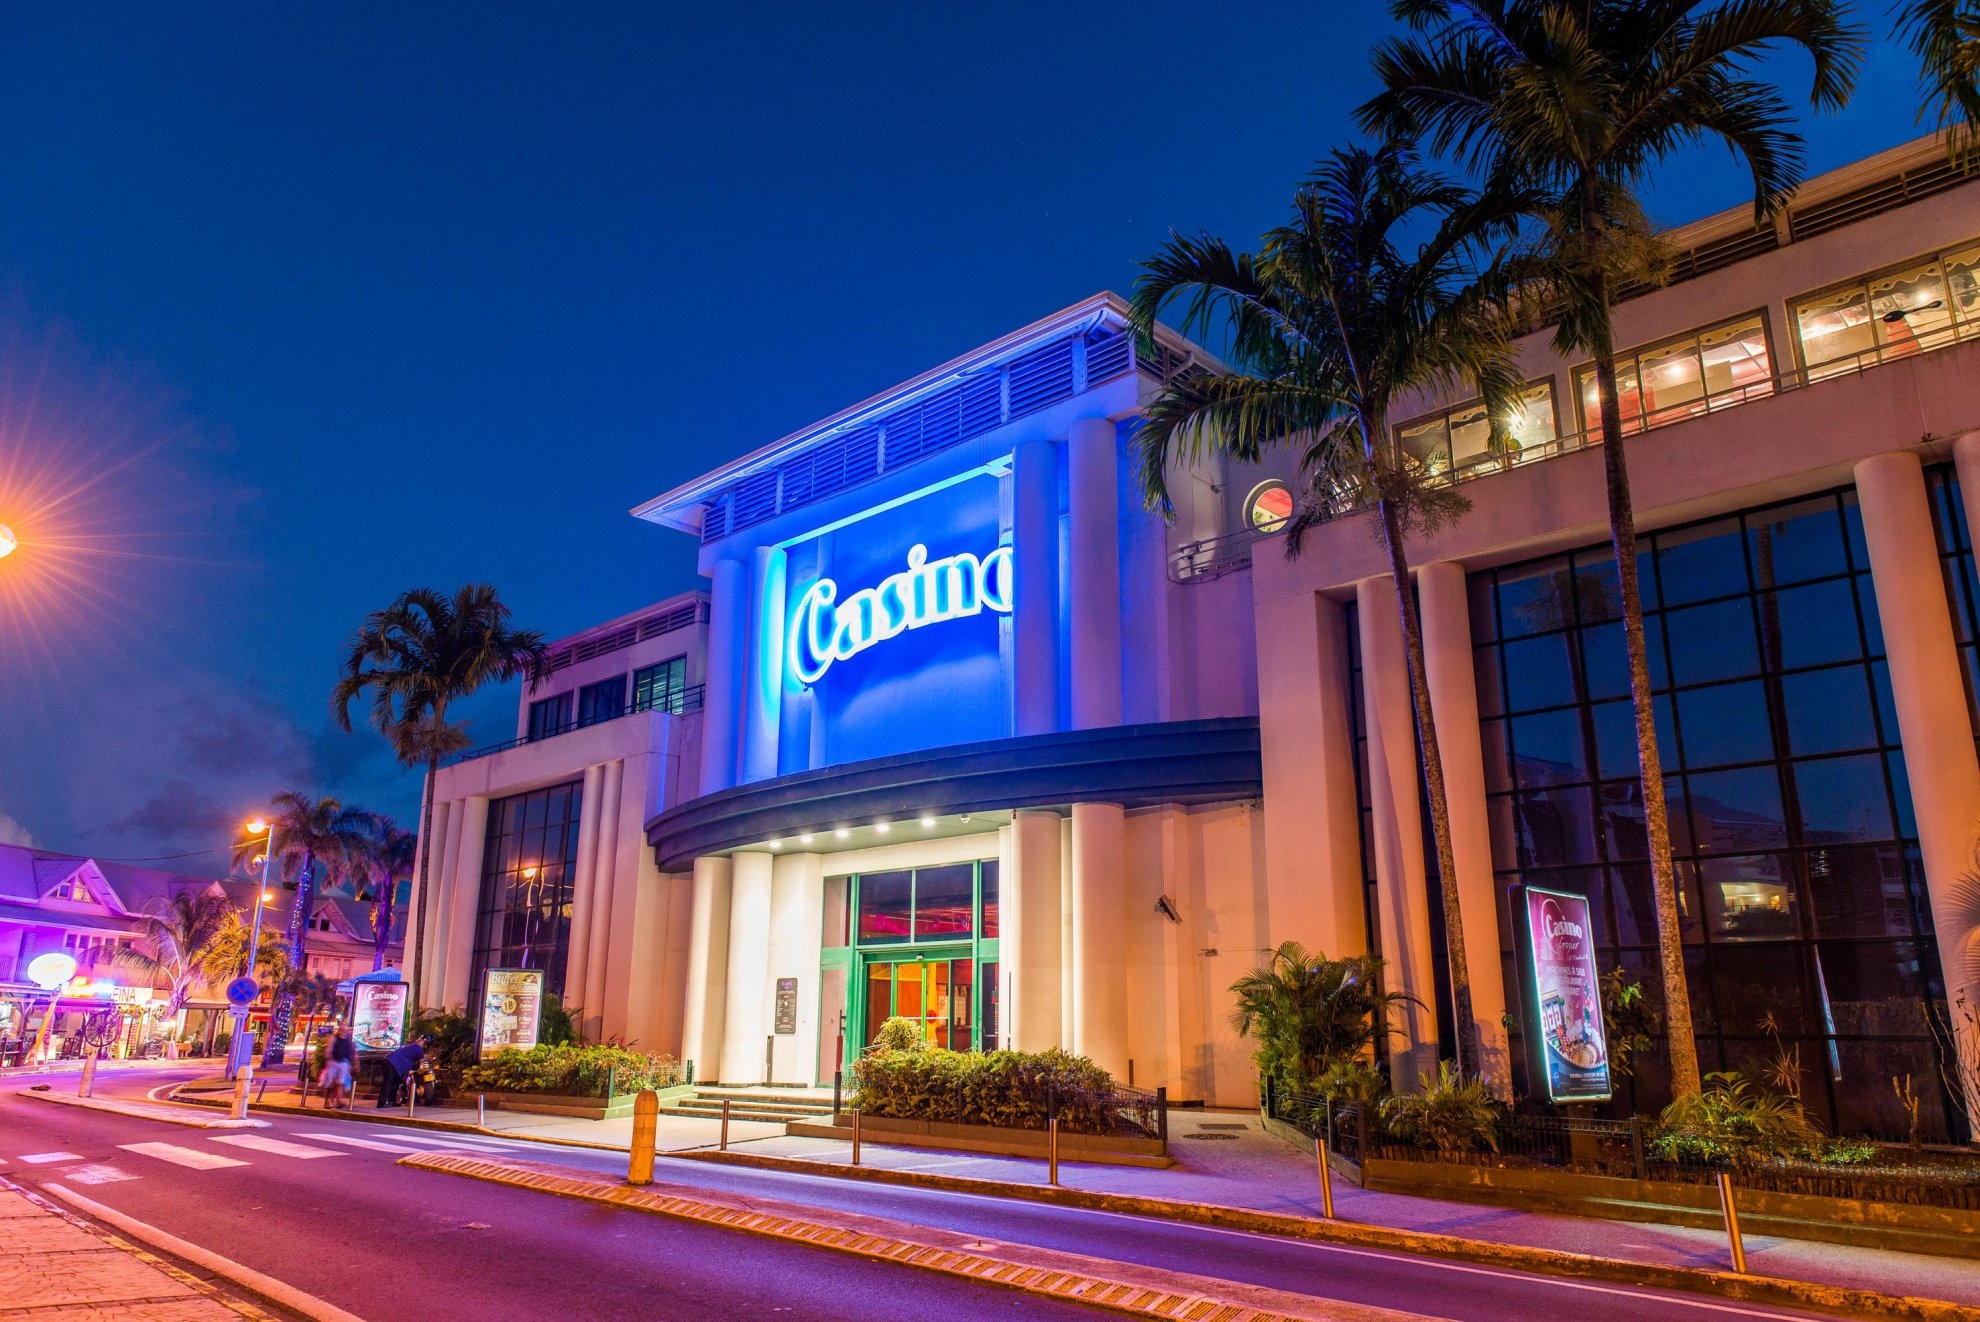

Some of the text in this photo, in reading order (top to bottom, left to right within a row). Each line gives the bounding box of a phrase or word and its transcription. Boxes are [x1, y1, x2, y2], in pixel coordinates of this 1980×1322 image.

[791, 543, 1013, 683] Casino
[1546, 914, 1583, 939] Casino
[490, 973, 519, 986] Buffet
[367, 990, 399, 1001] Casino
